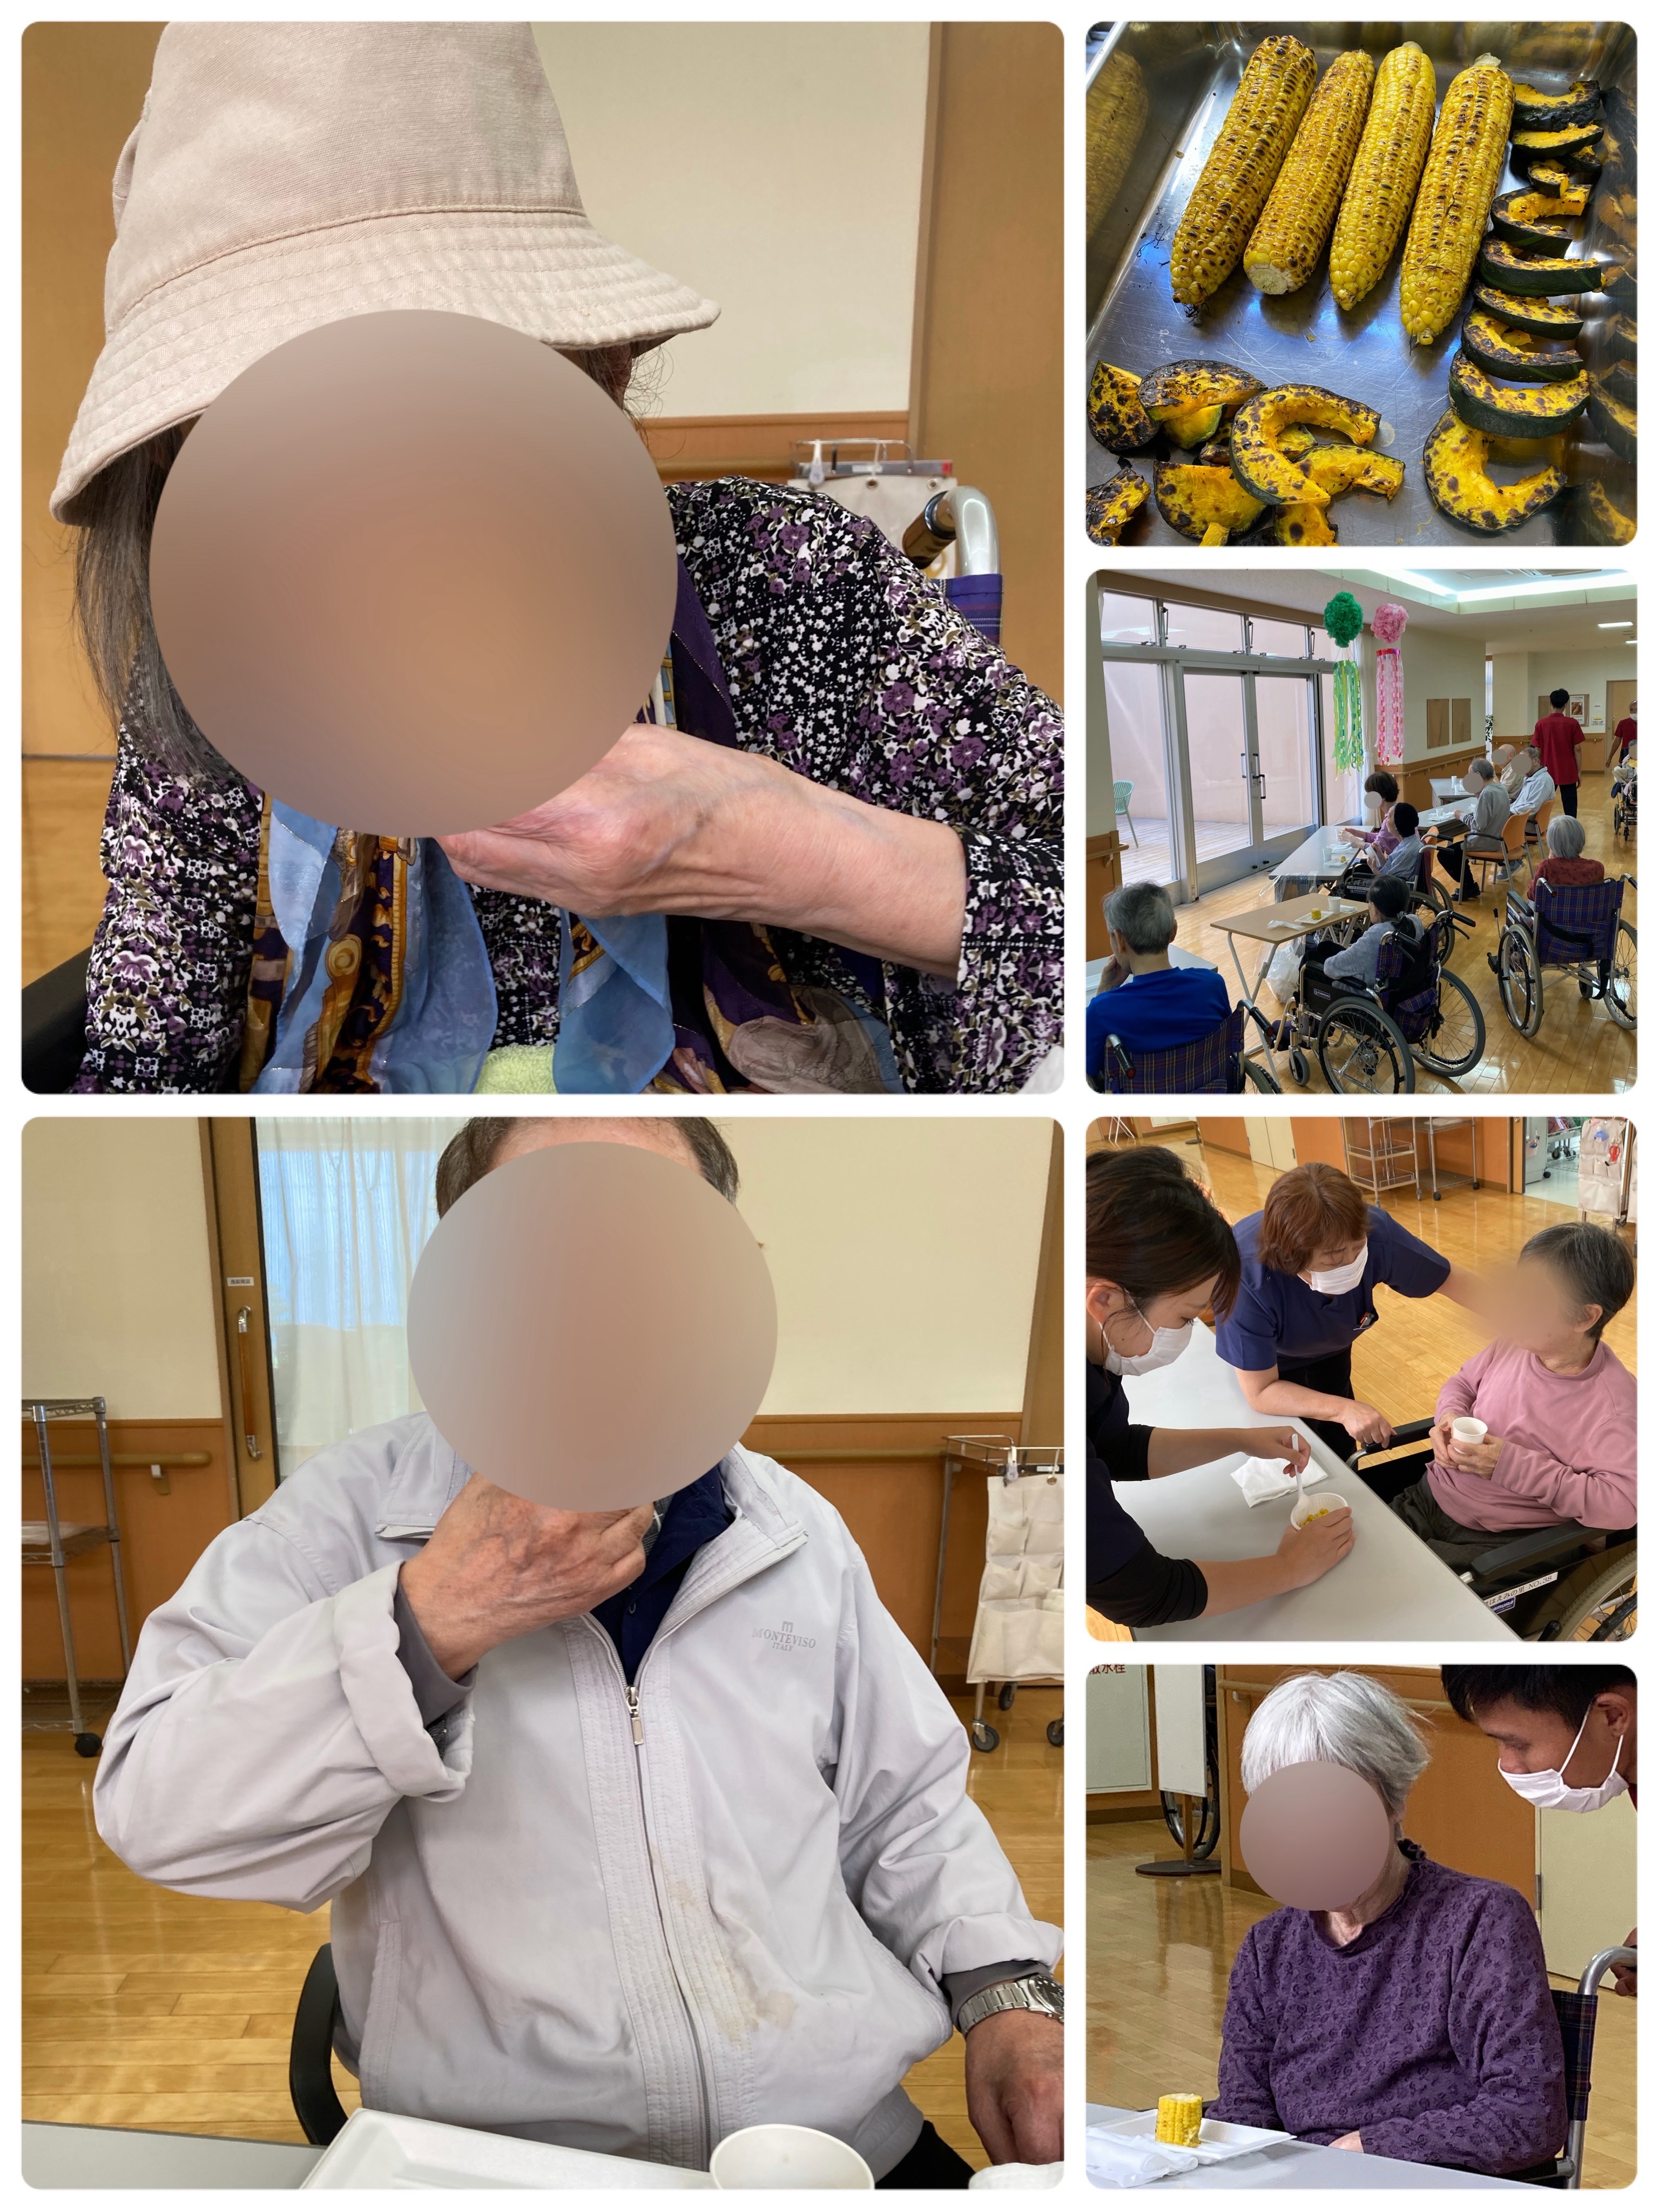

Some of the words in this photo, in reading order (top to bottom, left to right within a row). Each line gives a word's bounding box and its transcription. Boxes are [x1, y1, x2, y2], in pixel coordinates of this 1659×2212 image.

[1528, 1575, 1552, 1589] NO.38
[1492, 1600, 1514, 1611] AMURA
[752, 1628, 816, 1649] MONTEVISO
[772, 1642, 794, 1652] ITALY
